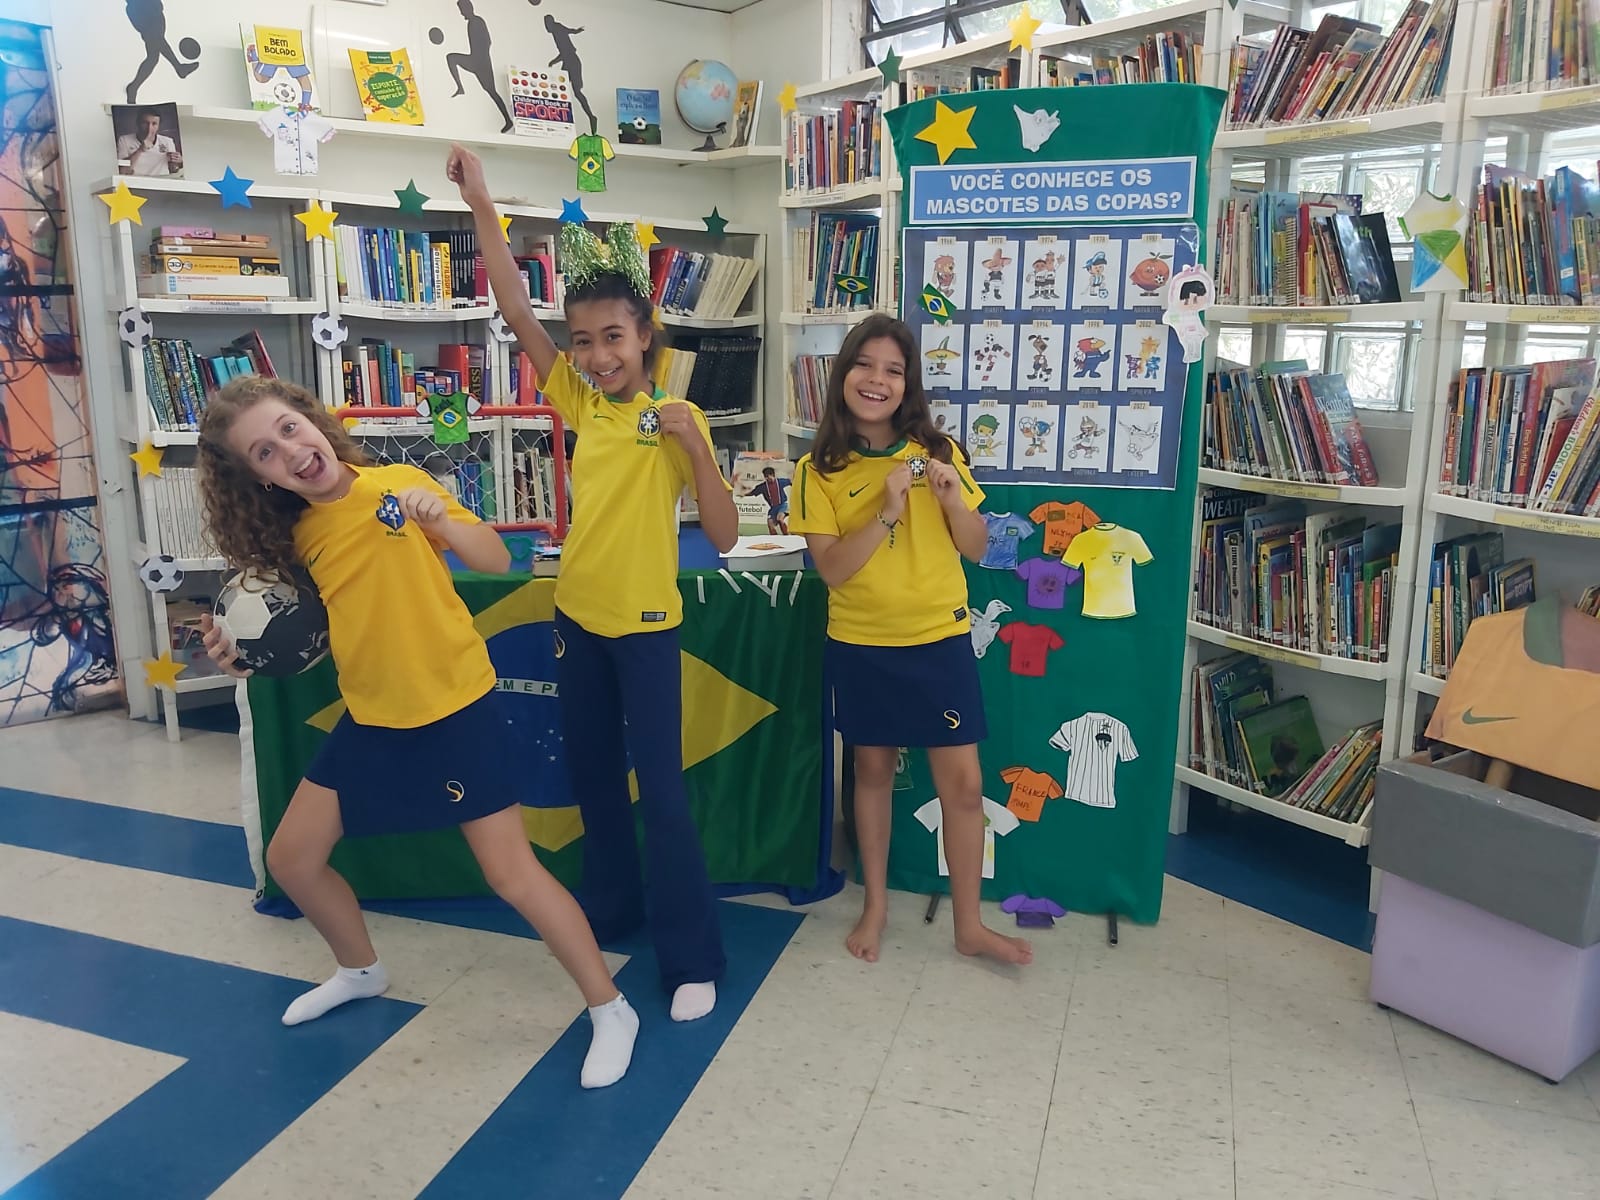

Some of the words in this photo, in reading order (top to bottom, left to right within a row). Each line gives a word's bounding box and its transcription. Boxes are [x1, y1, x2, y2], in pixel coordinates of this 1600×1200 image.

[263, 45, 297, 57] BOLADO
[269, 37, 289, 48] BEM
[514, 101, 570, 122] SPORT
[950, 169, 1005, 191] VOCÊ
[1011, 170, 1114, 189] CONHECE
[1120, 168, 1152, 187] OS
[926, 195, 1040, 215] MASCOTES
[1046, 194, 1089, 212] DAS
[1096, 191, 1182, 211] COPAS?
[636, 438, 659, 447] BRASIL
[1558, 435, 1576, 466] BOOK
[1544, 470, 1558, 490] art
[523, 681, 533, 692] E
